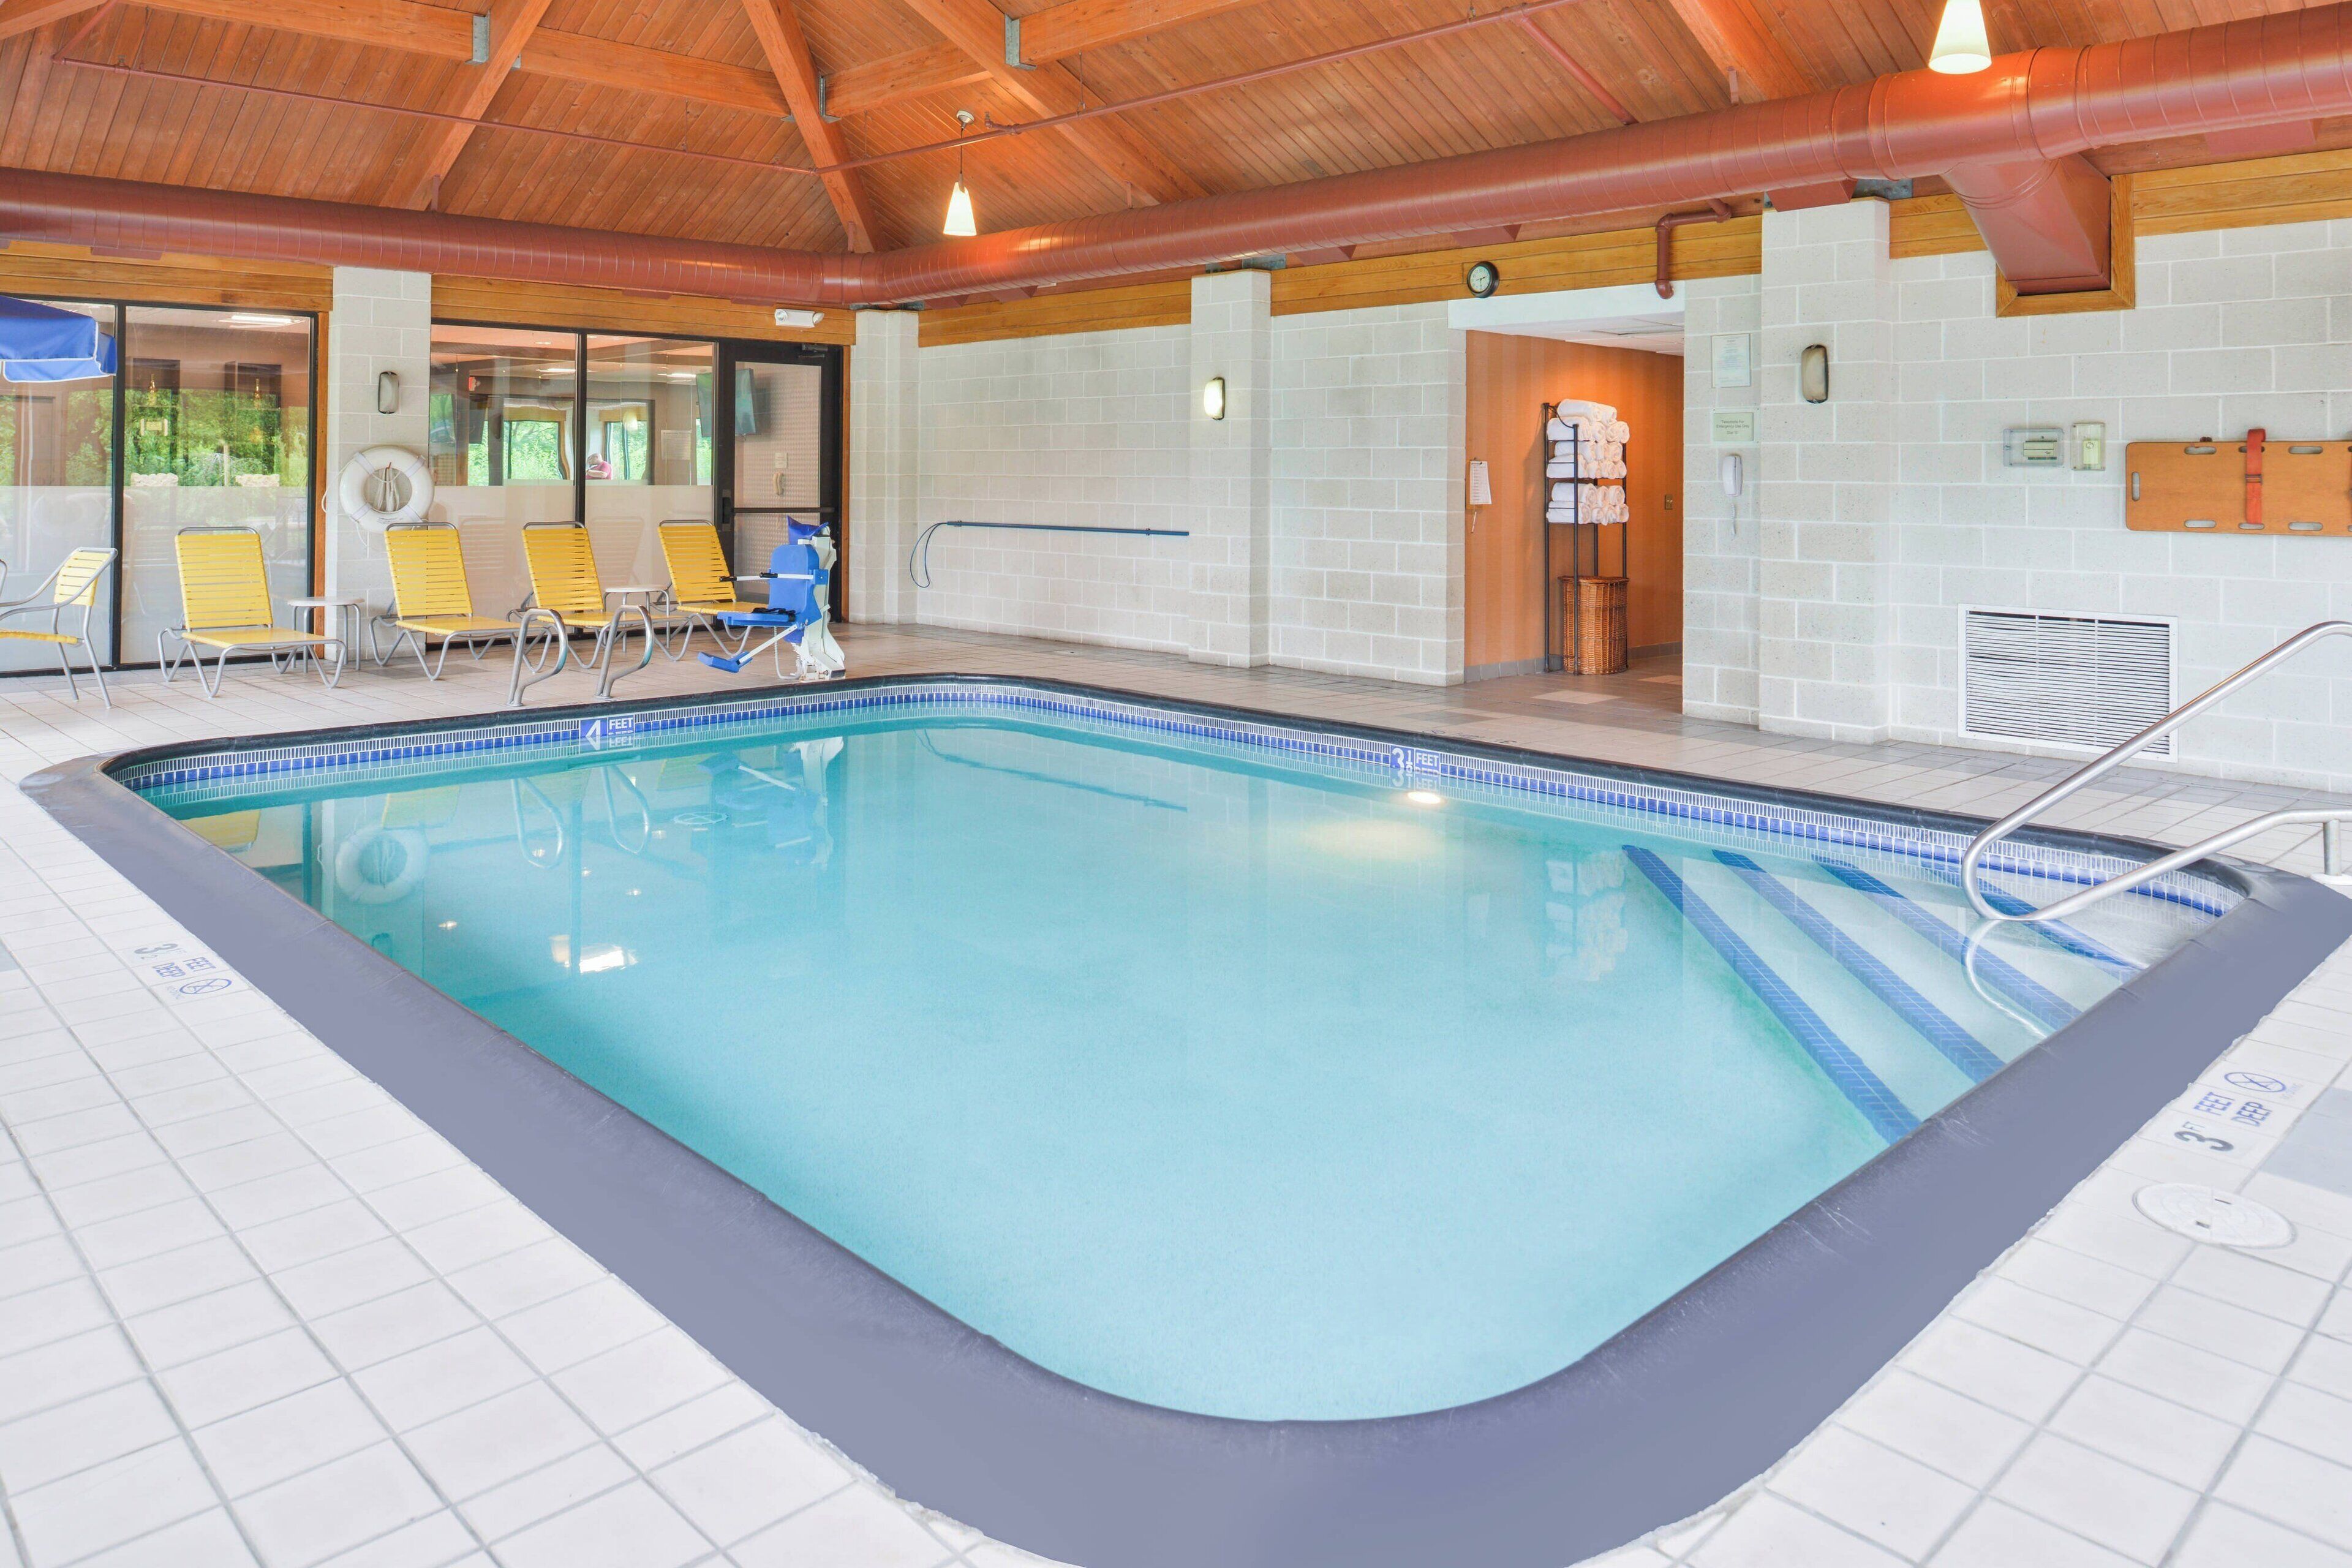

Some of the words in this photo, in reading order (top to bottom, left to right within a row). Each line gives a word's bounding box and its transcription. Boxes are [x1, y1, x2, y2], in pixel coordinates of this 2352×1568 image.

[609, 717, 633, 730] FEET
[1416, 752, 1439, 767] FEET
[152, 962, 186, 978] DEEP
[182, 956, 217, 973] FEET
[2193, 1091, 2236, 1117] FEET
[2231, 1101, 2274, 1127] DEEP
[2182, 1121, 2206, 1133] FT
[2174, 1131, 2234, 1152] 3
